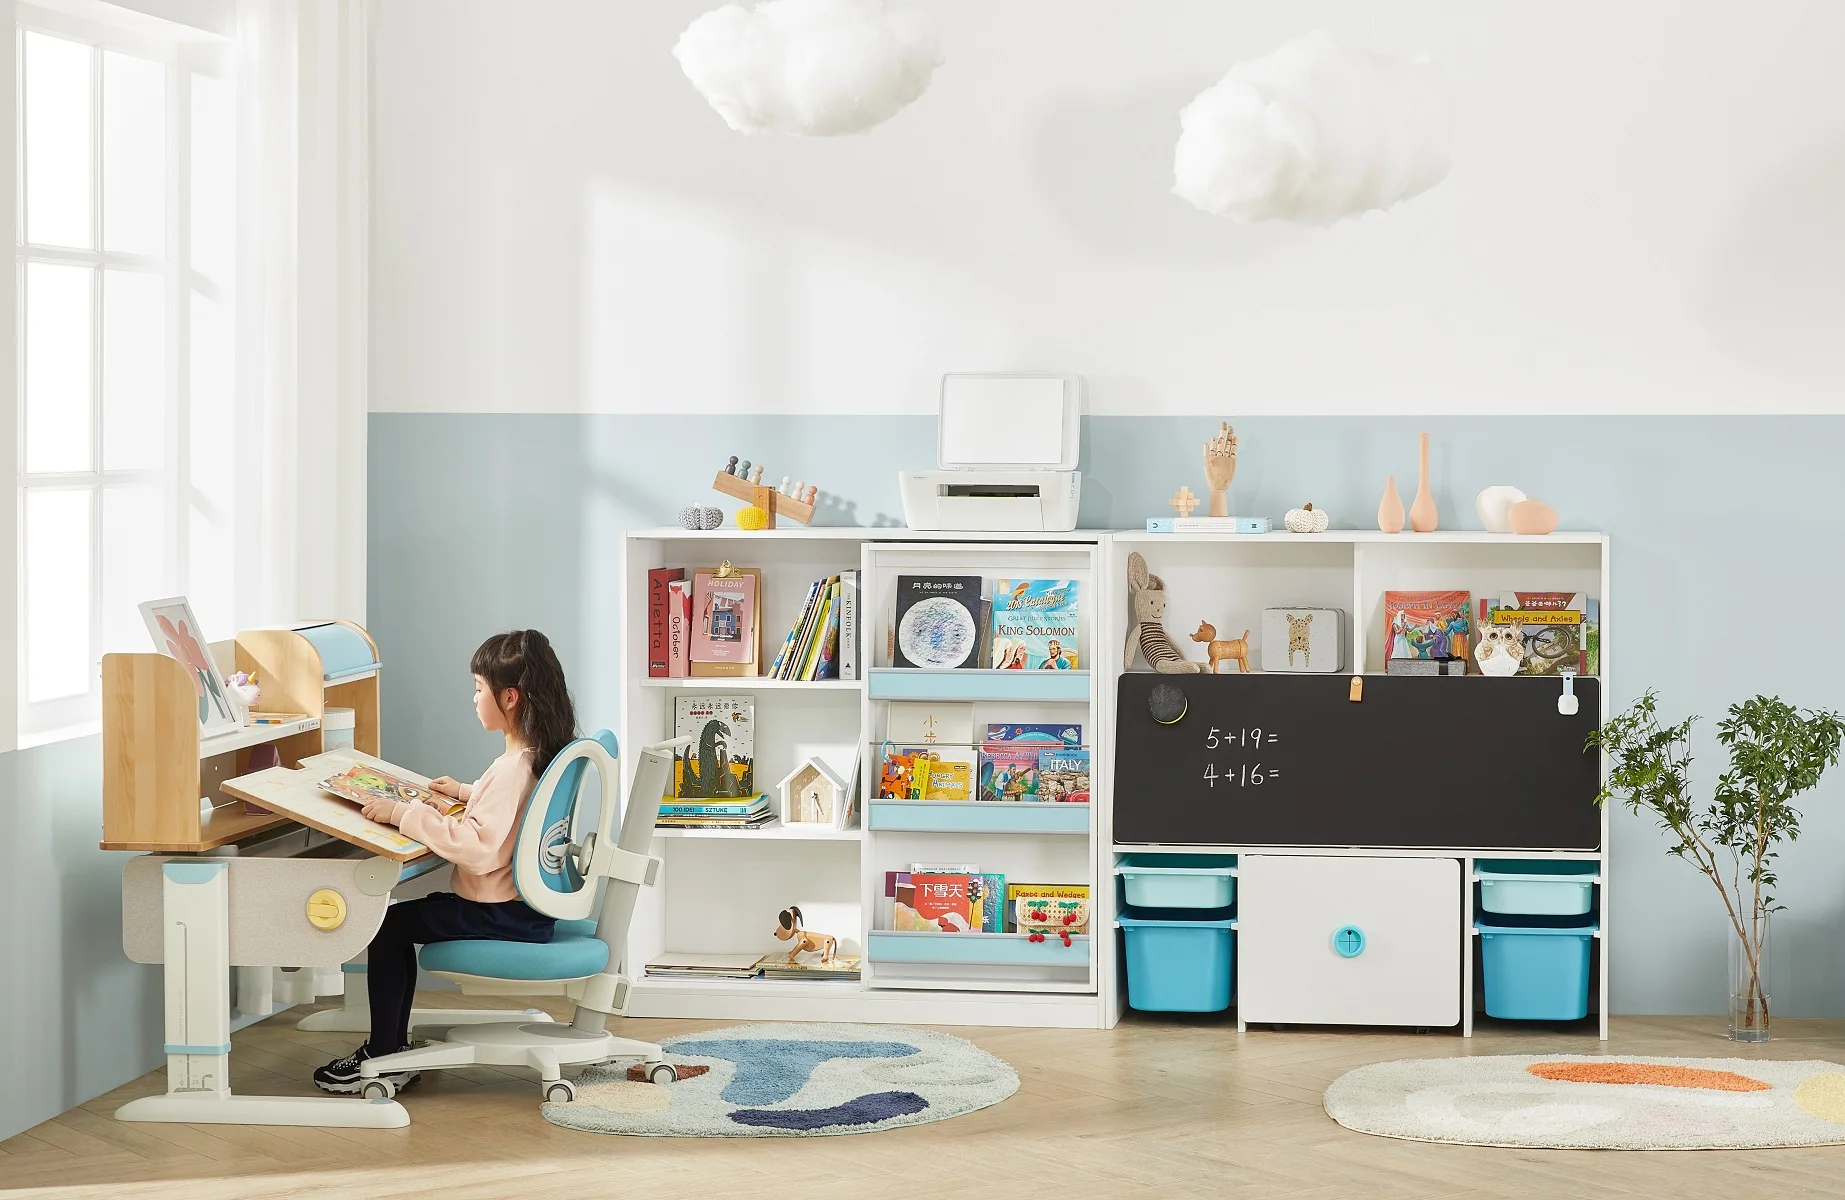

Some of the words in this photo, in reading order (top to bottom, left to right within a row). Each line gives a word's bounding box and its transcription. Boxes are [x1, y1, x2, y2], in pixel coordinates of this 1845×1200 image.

[708, 580, 744, 588] HOLIDAY
[653, 578, 664, 649] Arletta
[998, 625, 1023, 636] KING
[1026, 625, 1075, 636] SOLOMON
[672, 616, 681, 659] October
[1050, 759, 1082, 770] ITALY
[919, 883, 963, 898] 下雪天
